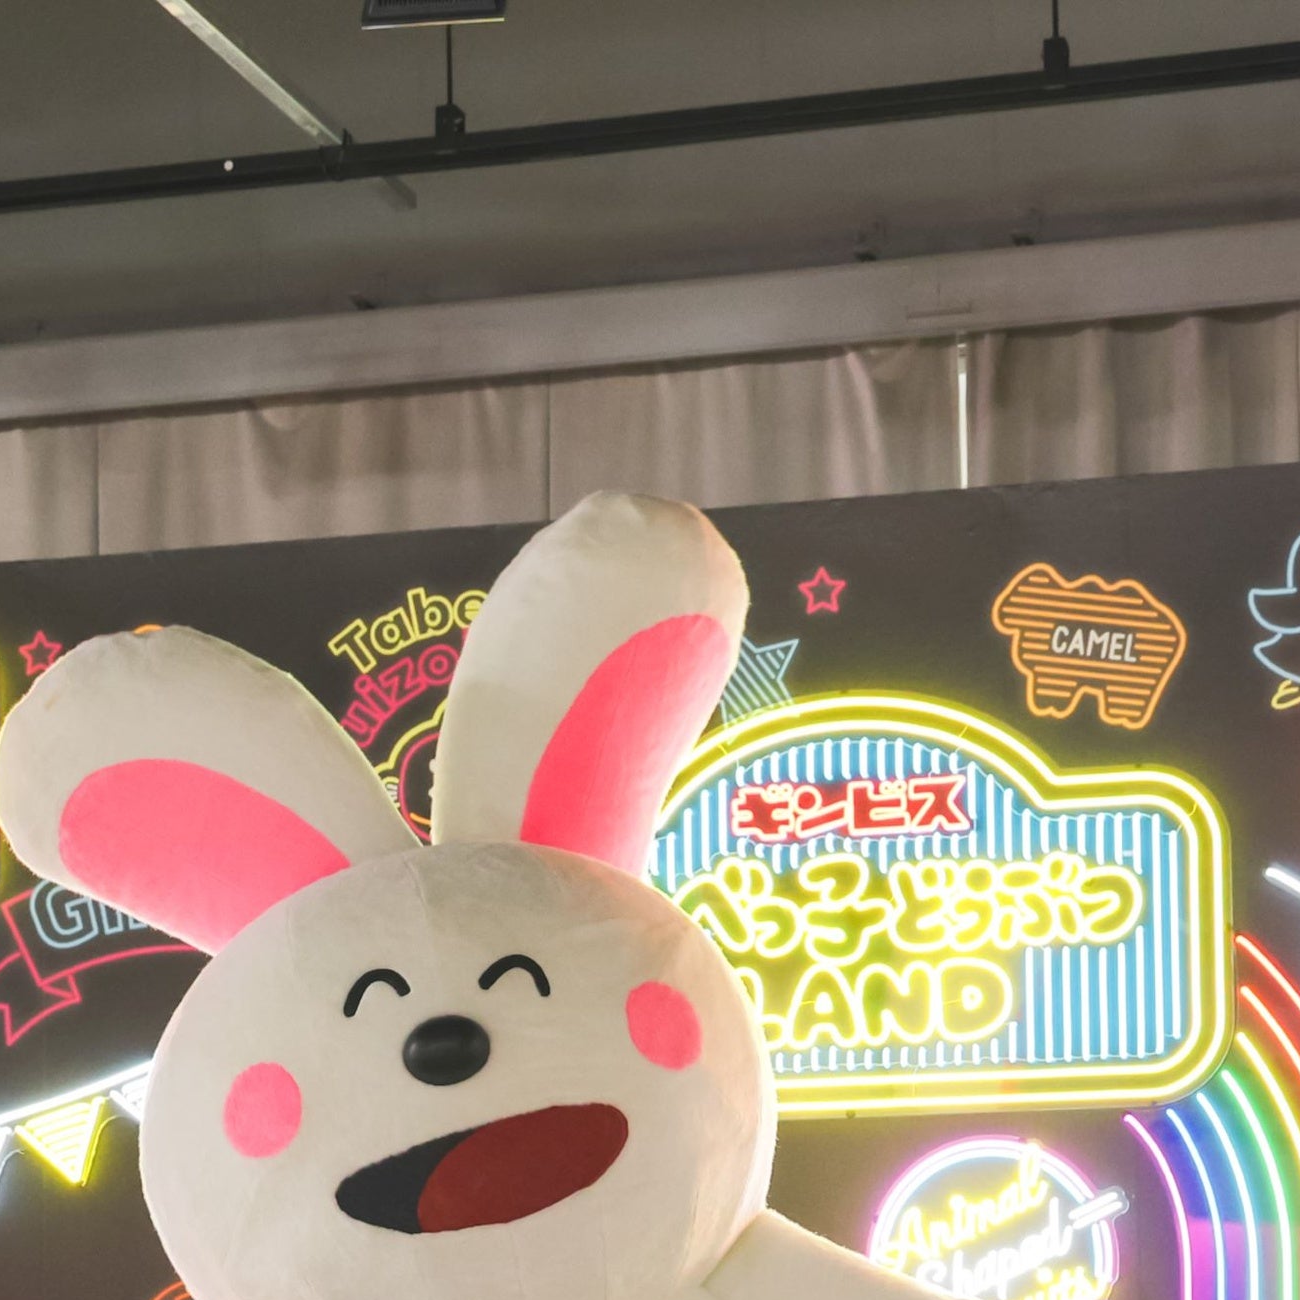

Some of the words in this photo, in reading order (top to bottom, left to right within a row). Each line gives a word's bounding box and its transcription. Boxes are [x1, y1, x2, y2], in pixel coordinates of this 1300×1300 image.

[1050, 624, 1138, 663] CAMEL
[731, 774, 972, 839] ギンビス
[872, 1142, 1049, 1271] Animal
[915, 1196, 1074, 1300] Shaped
